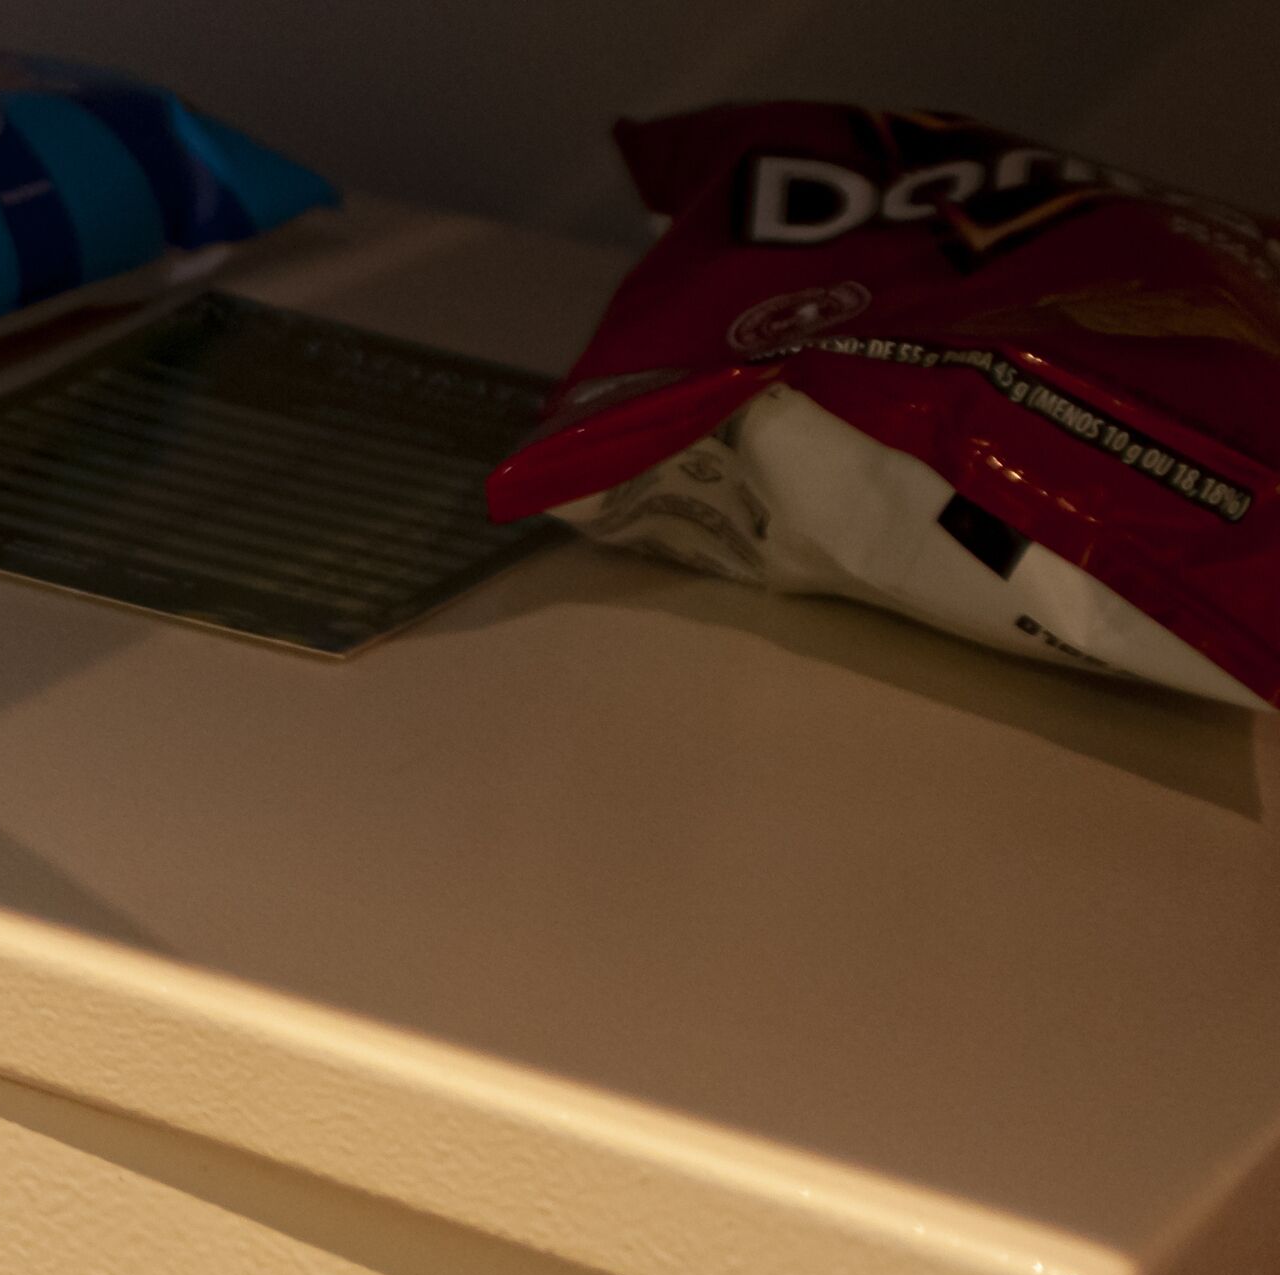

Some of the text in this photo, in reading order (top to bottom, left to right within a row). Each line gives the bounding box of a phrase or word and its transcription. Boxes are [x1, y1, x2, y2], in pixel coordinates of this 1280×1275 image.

[864, 338, 896, 361] DE
[894, 342, 924, 364] 55
[991, 361, 1019, 390] 45
[1008, 381, 1030, 403] g
[1025, 384, 1105, 440] (MENOS
[1100, 425, 1131, 453] 10
[1121, 442, 1143, 466] g
[1140, 447, 1177, 477] OU
